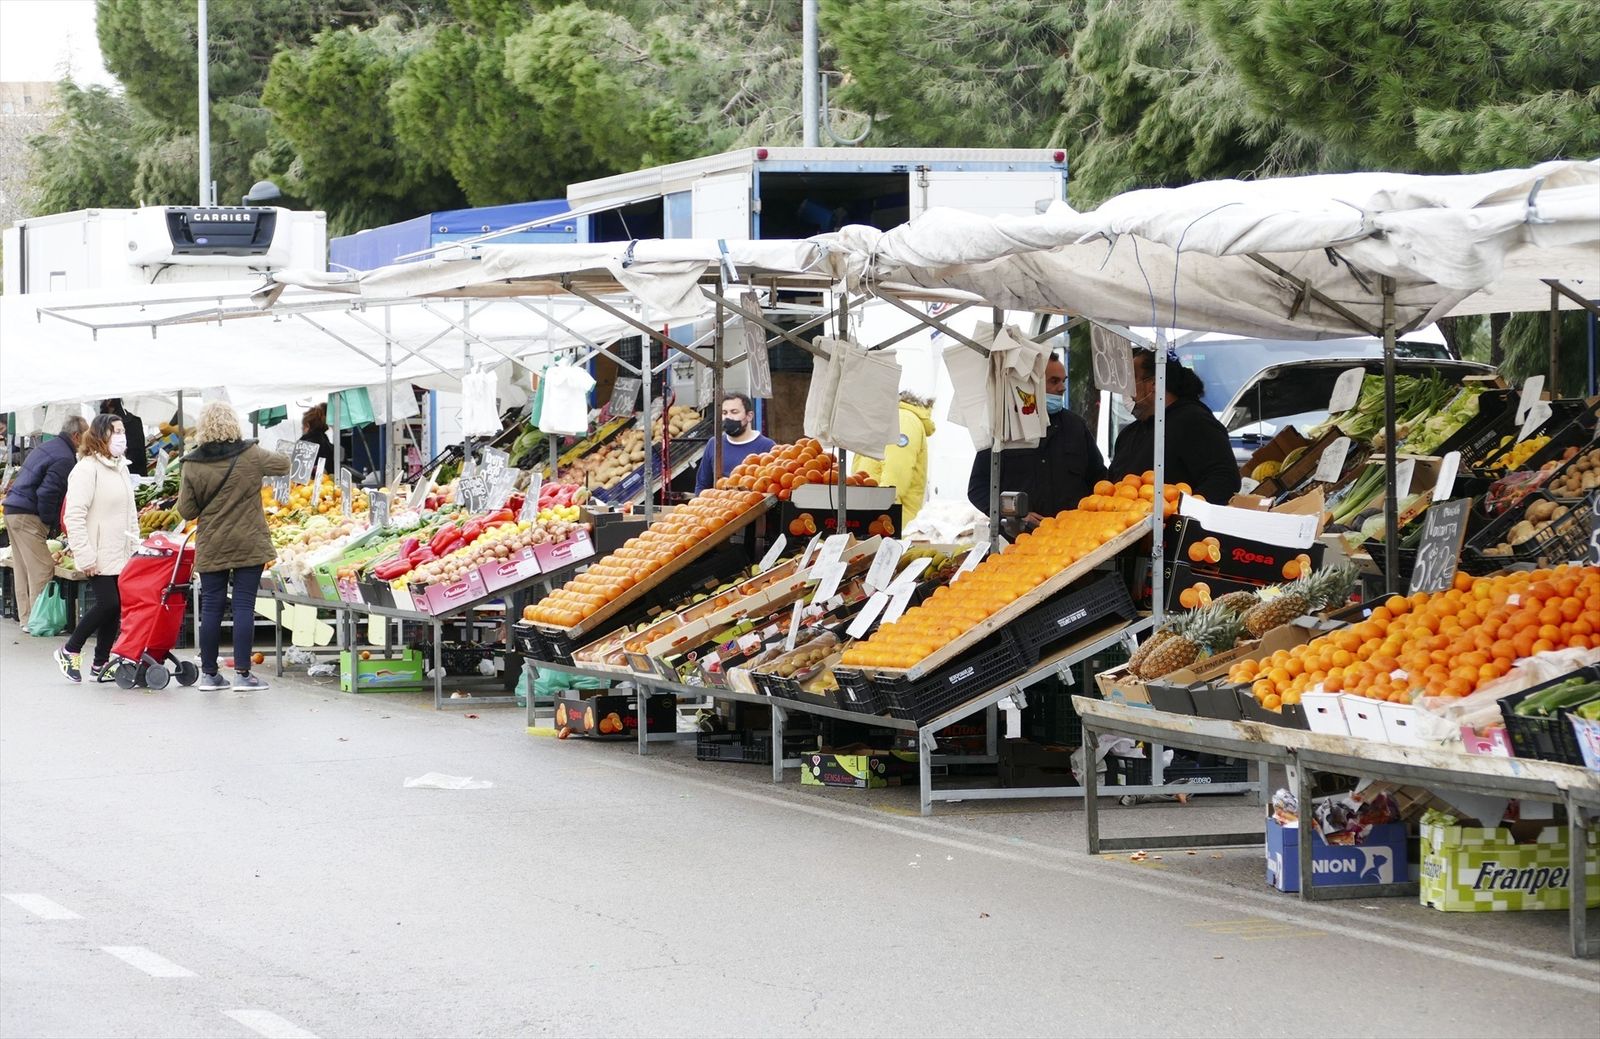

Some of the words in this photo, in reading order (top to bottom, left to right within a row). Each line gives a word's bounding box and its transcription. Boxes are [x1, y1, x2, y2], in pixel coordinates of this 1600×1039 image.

[193, 213, 251, 221] CARRIER
[1232, 547, 1276, 565] Rosa
[1312, 858, 1356, 874] NION
